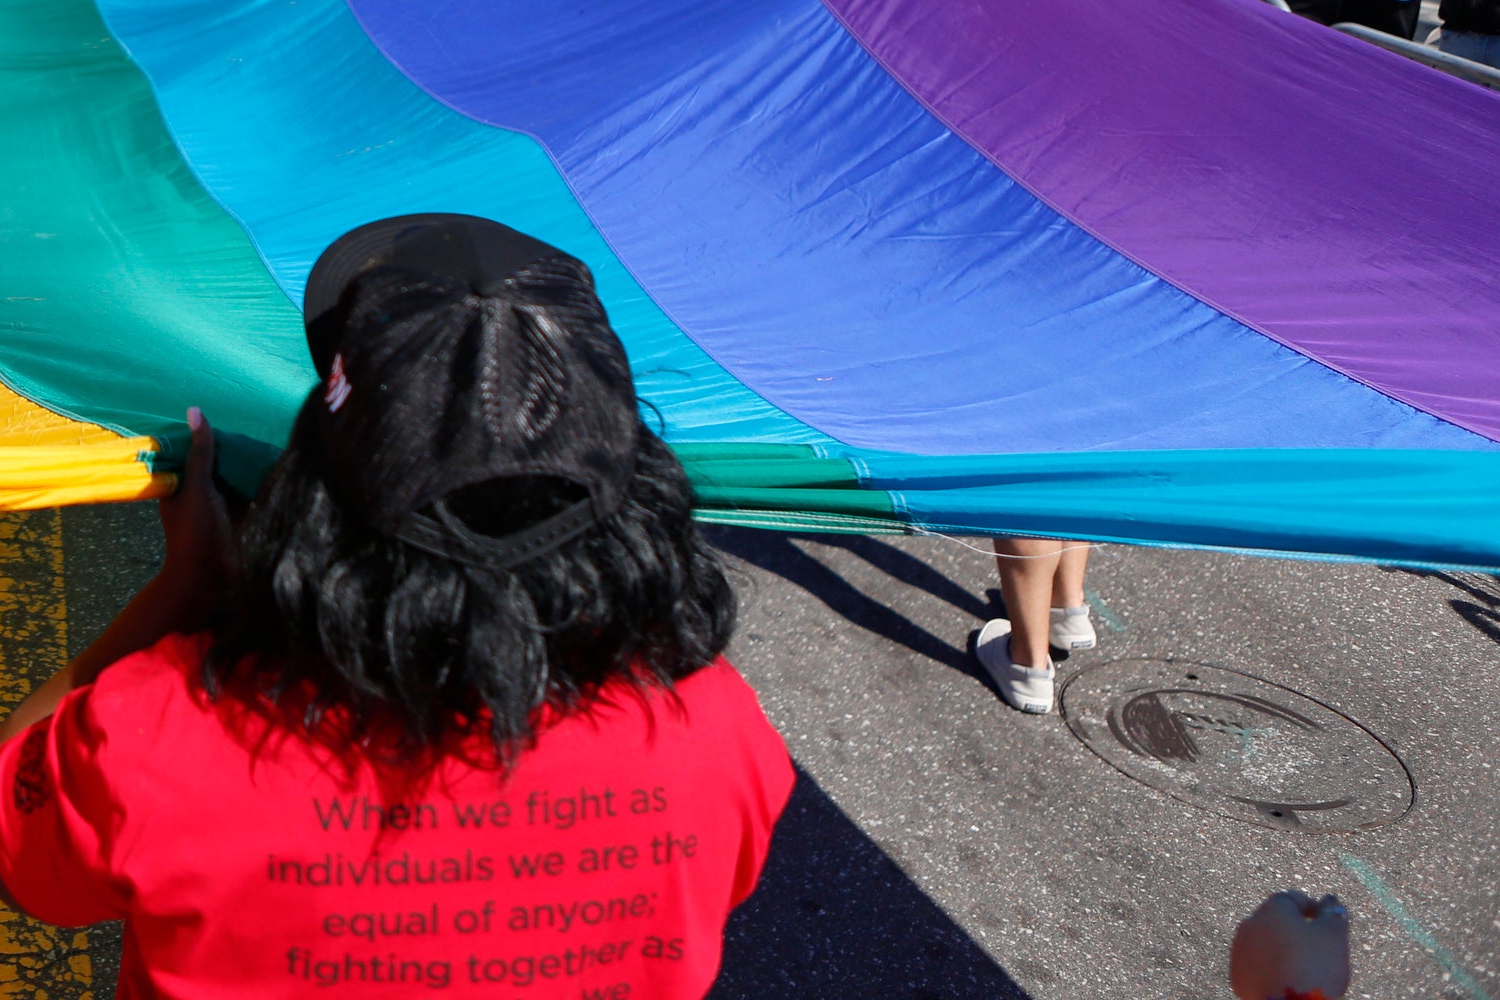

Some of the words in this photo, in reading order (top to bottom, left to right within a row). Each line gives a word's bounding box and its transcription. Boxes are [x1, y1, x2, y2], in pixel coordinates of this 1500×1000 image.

[312, 796, 438, 832] When
[452, 800, 512, 829] we
[526, 787, 617, 830] fight
[629, 786, 668, 815] as
[267, 849, 495, 887] individuals
[508, 851, 565, 880] we
[577, 844, 639, 873] are
[650, 831, 699, 865] the
[322, 902, 440, 941] equal
[452, 899, 496, 935] of
[507, 892, 658, 934] anyone;
[285, 947, 453, 988] fighting
[466, 936, 633, 988] together
[641, 934, 685, 961] as
